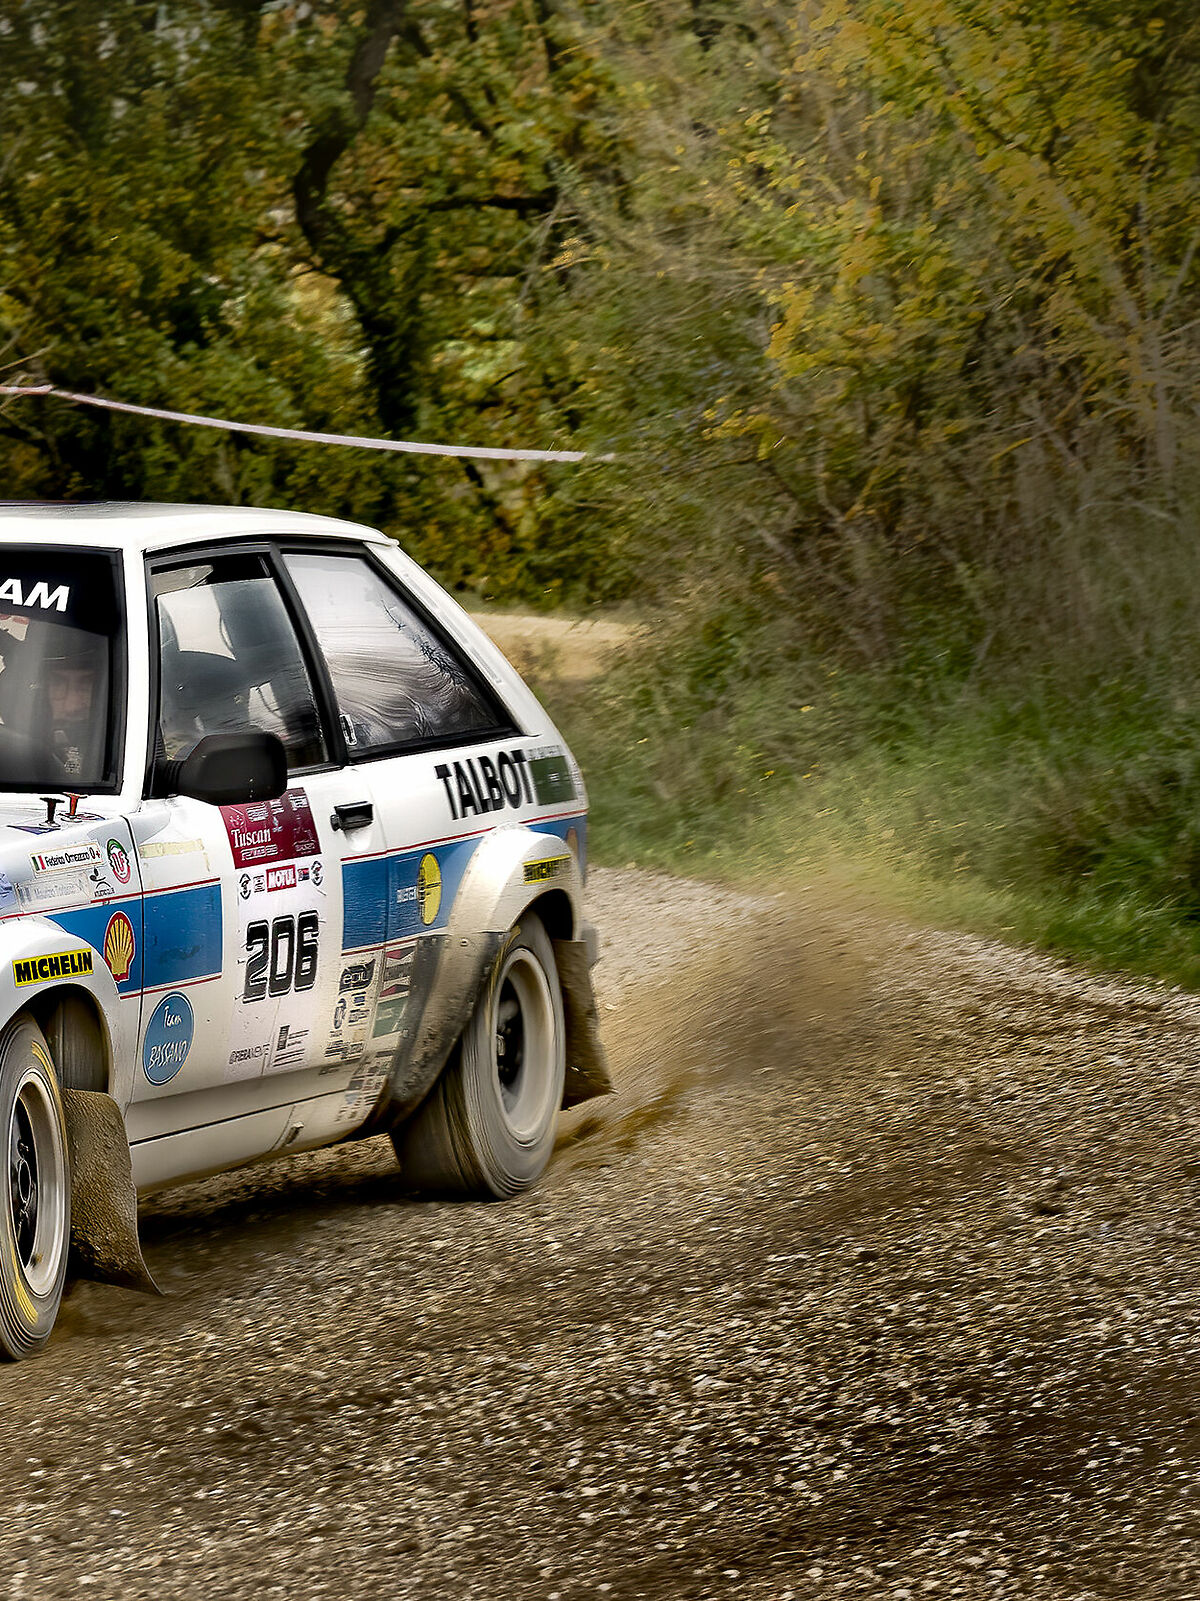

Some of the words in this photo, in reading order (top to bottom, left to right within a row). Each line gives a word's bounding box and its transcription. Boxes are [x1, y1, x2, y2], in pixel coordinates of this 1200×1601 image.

[434, 749, 534, 820] TALBOT
[231, 828, 272, 848] Tuscan
[268, 867, 296, 889] MOTUL
[15, 952, 94, 983] MICHELIN
[242, 910, 319, 1004] 206
[164, 1005, 182, 1028] Team
